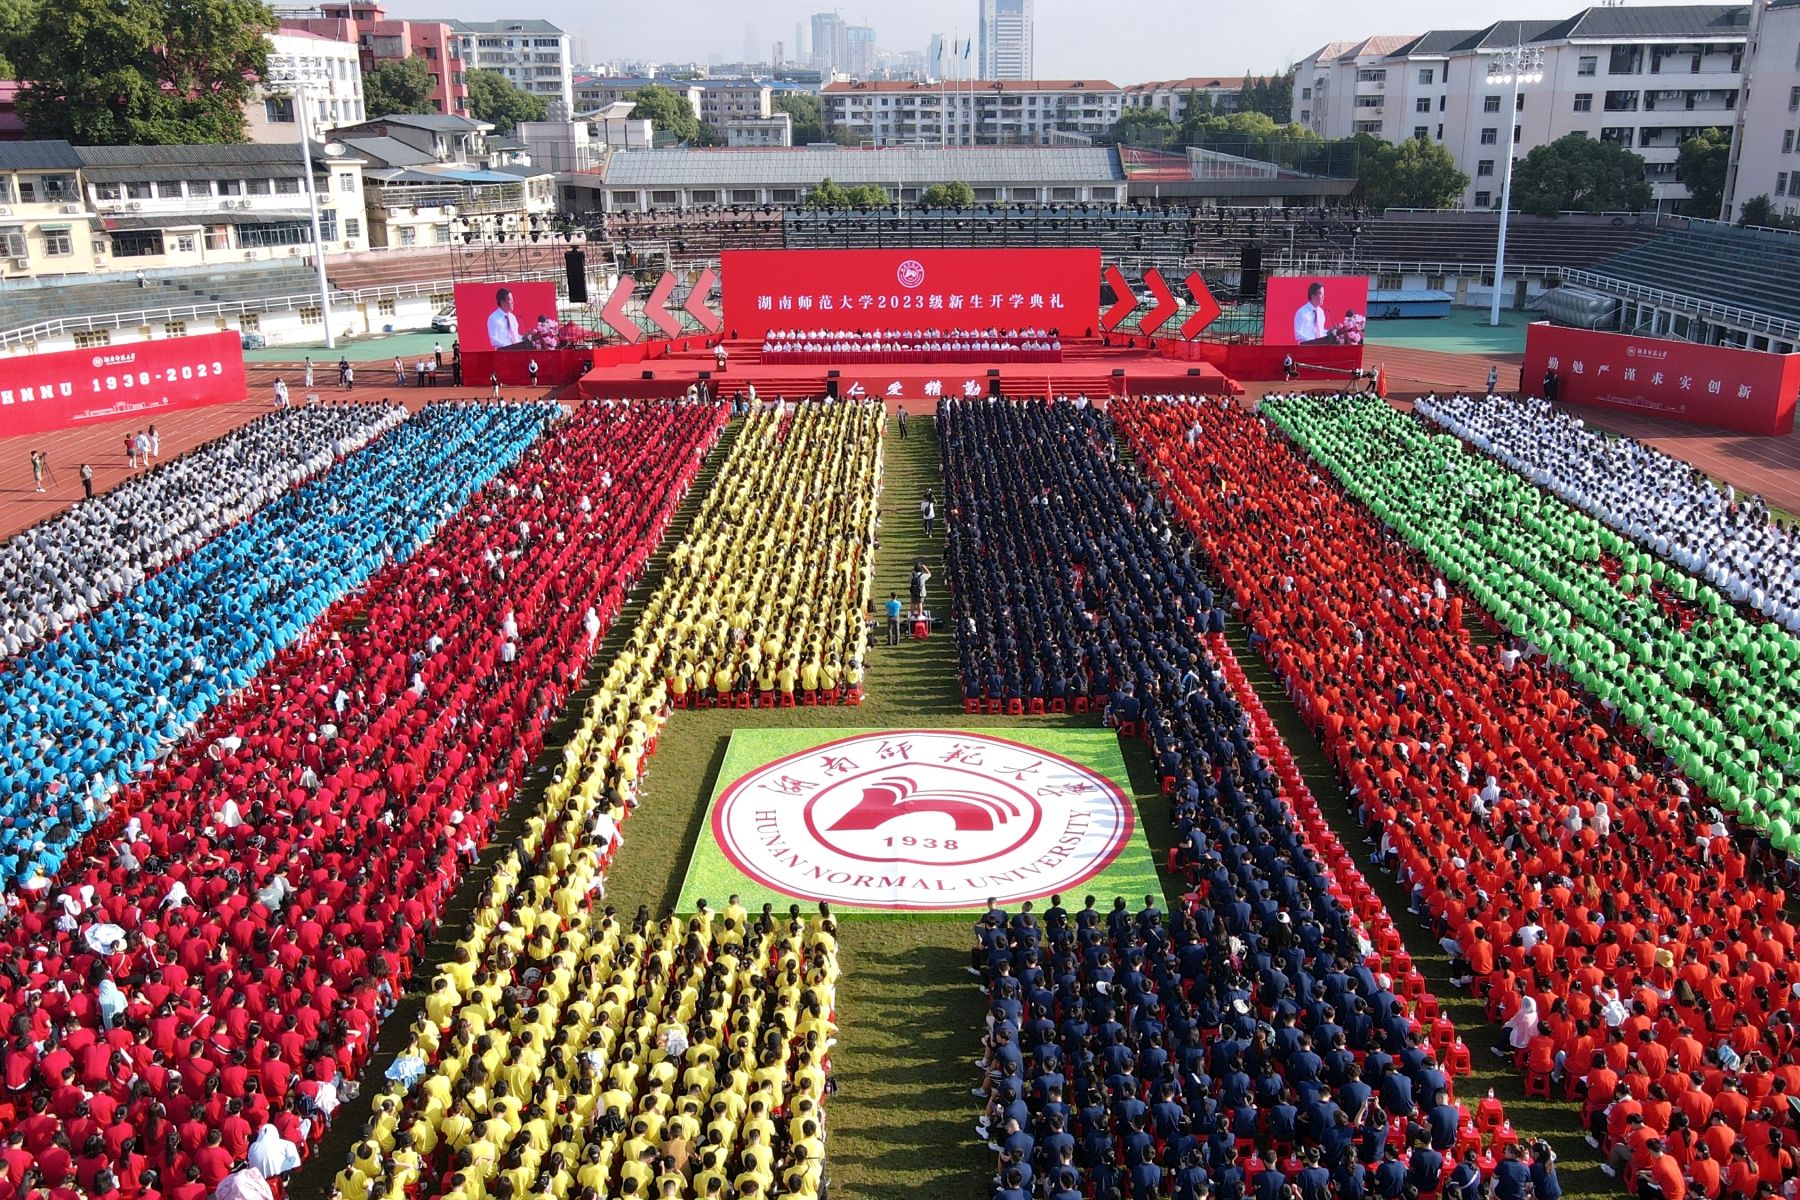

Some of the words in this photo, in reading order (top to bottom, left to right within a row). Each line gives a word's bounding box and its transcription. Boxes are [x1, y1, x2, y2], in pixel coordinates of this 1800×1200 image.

[757, 294, 1065, 311] 湖南师范大学2023级新生开学典礼
[0, 382, 73, 405] HNNU
[92, 362, 223, 392] 1938-2023
[1547, 356, 1752, 399] 勤勉严谨求实创新
[755, 809, 808, 868] HUNAN
[803, 865, 956, 891] NORMAL
[963, 808, 1092, 890] UNIVERSITY
[882, 835, 959, 851] 1938
